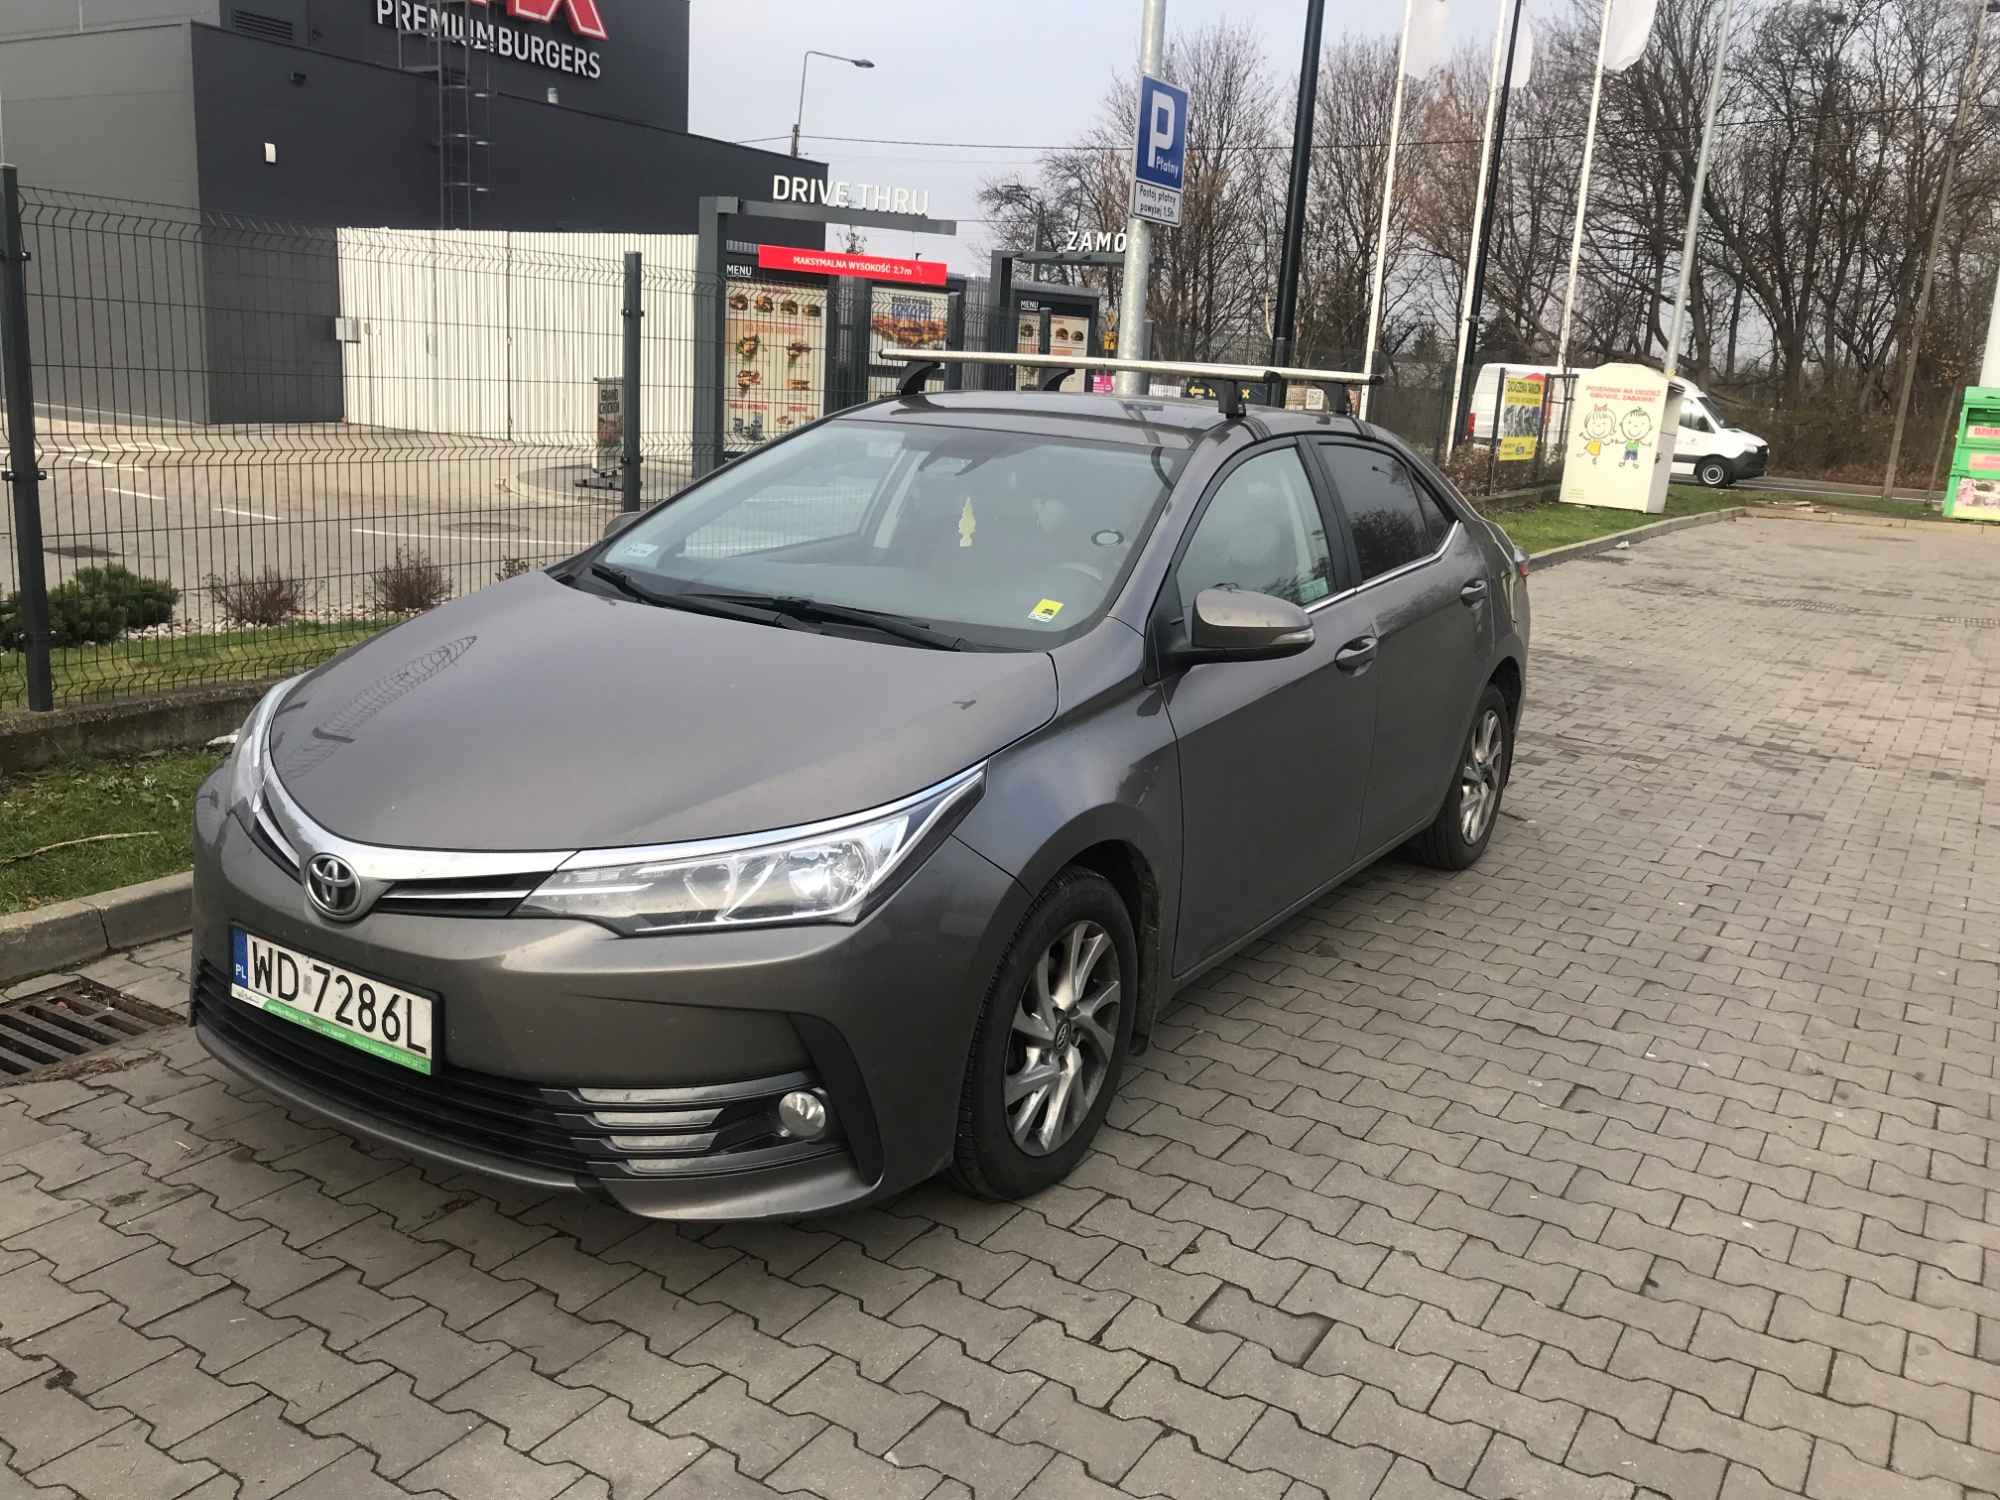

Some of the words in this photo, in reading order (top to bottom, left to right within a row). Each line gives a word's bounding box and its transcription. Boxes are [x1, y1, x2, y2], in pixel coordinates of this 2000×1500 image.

[376, 0, 495, 53] PREMIUM
[498, 27, 601, 79] BURGERS
[1147, 89, 1176, 168] P
[772, 174, 849, 206] DRIVE
[857, 182, 929, 215] THRU
[1066, 229, 1127, 253] ZAMÓ
[726, 264, 752, 276] MENU
[793, 255, 847, 269] MAKSYMALNA
[848, 261, 890, 274] WYSOKOŚĆ
[1020, 299, 1039, 310] MENU
[235, 963, 247, 979] PL
[252, 941, 300, 1002] WD
[312, 964, 427, 1055] 7286L
